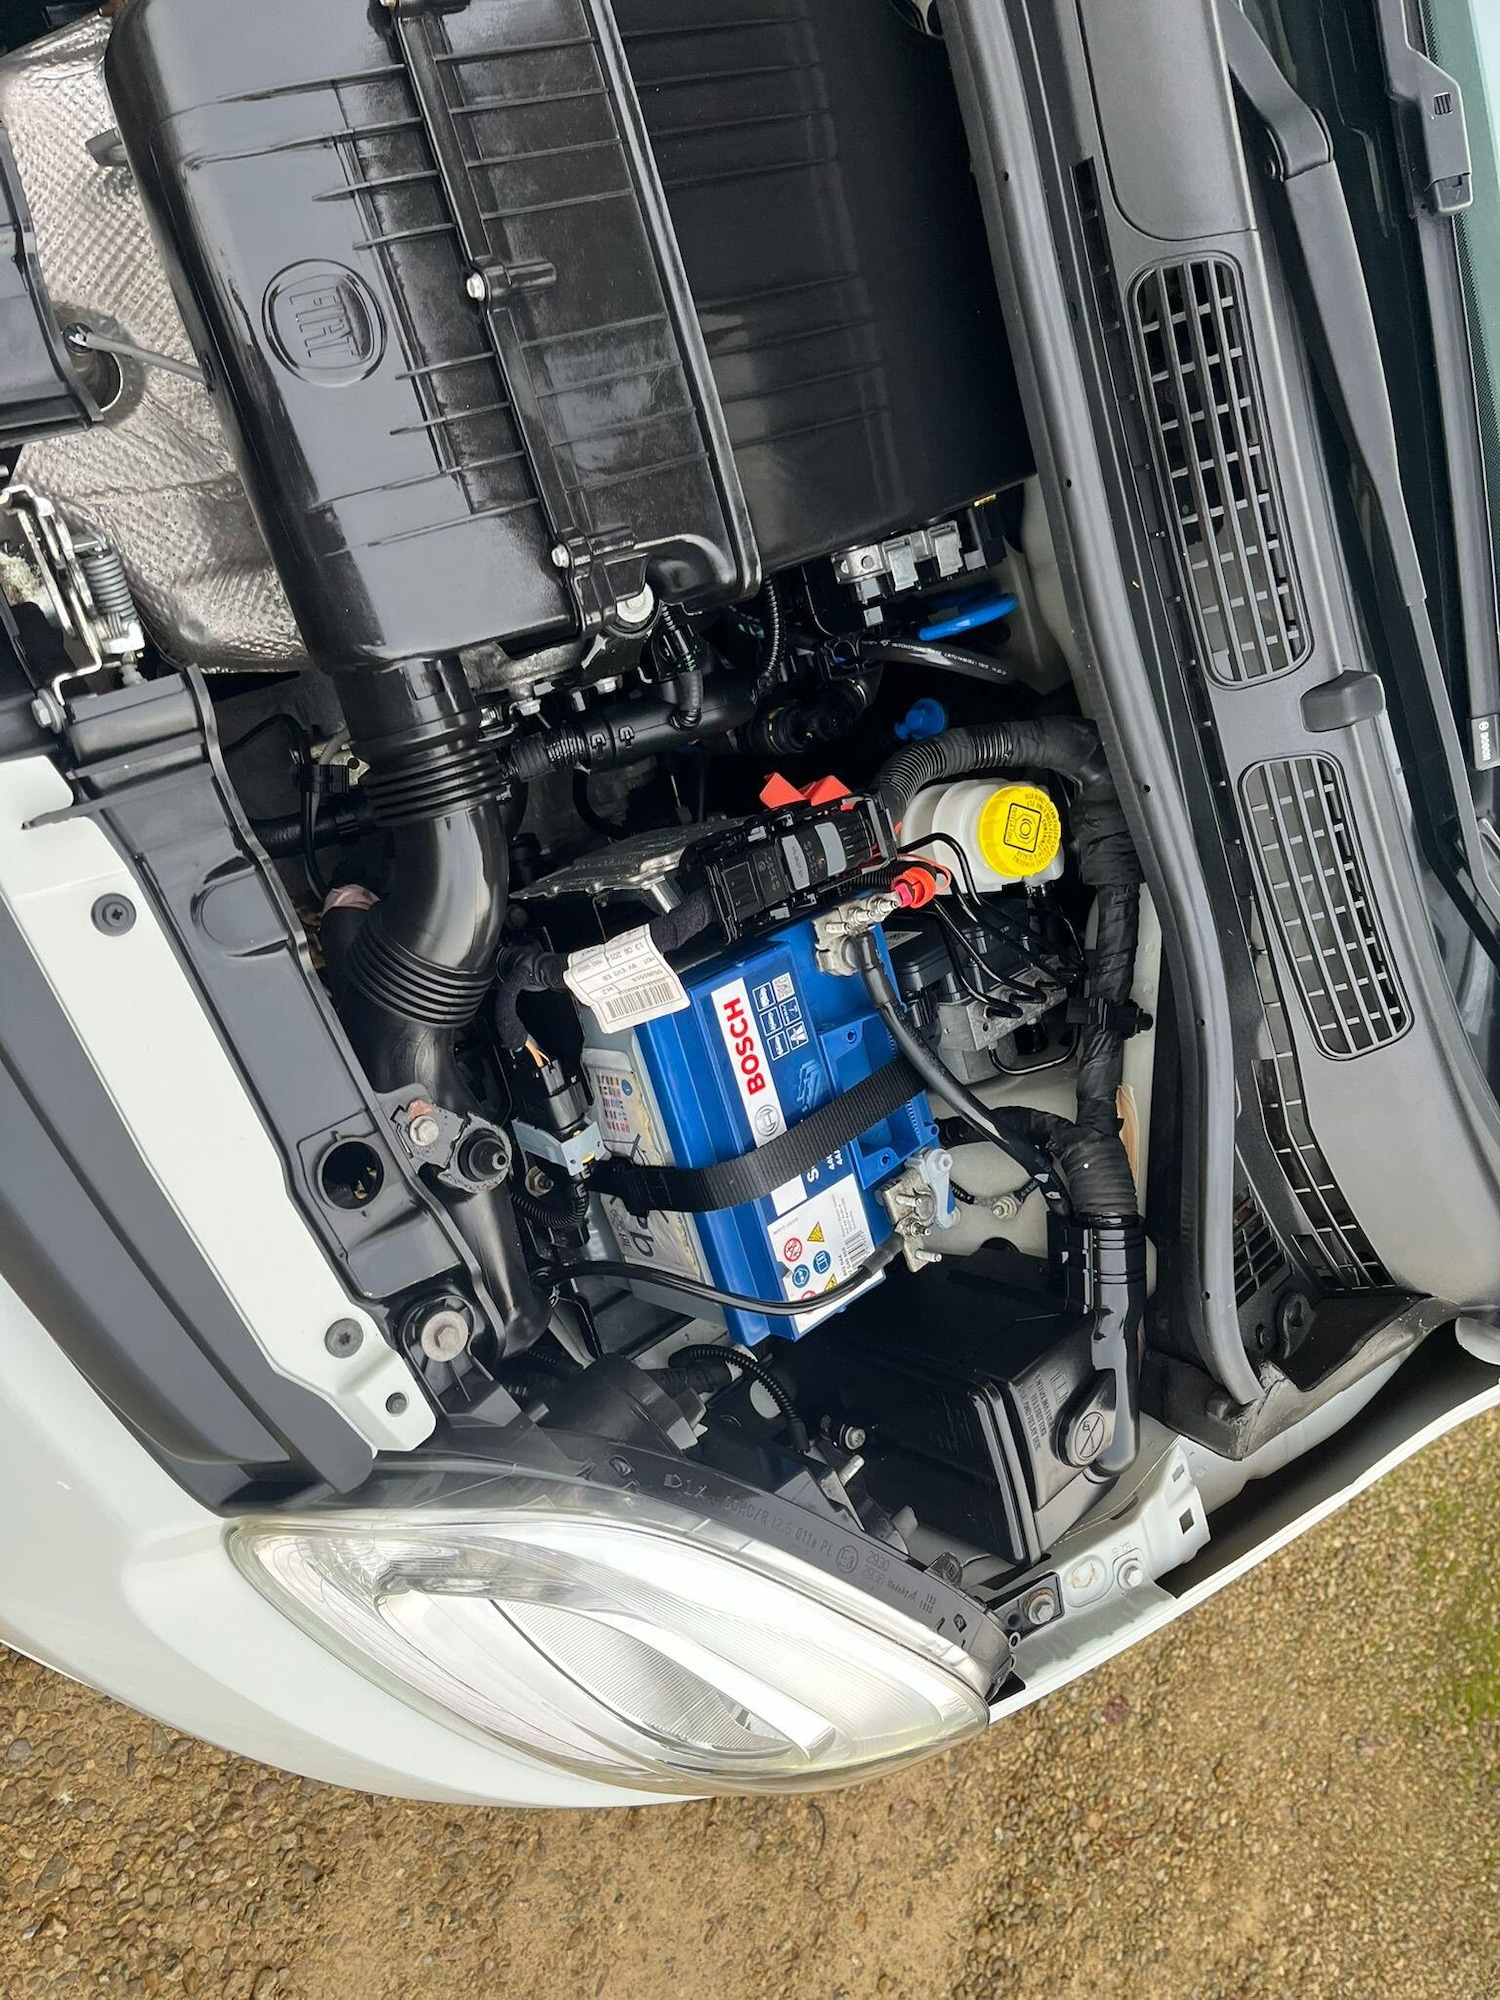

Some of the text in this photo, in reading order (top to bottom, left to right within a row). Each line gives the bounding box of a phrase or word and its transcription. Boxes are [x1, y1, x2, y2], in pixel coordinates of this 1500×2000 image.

[289, 286, 364, 361] FIAT
[724, 999, 765, 1094] BOSCH
[806, 1164, 820, 1183] S
